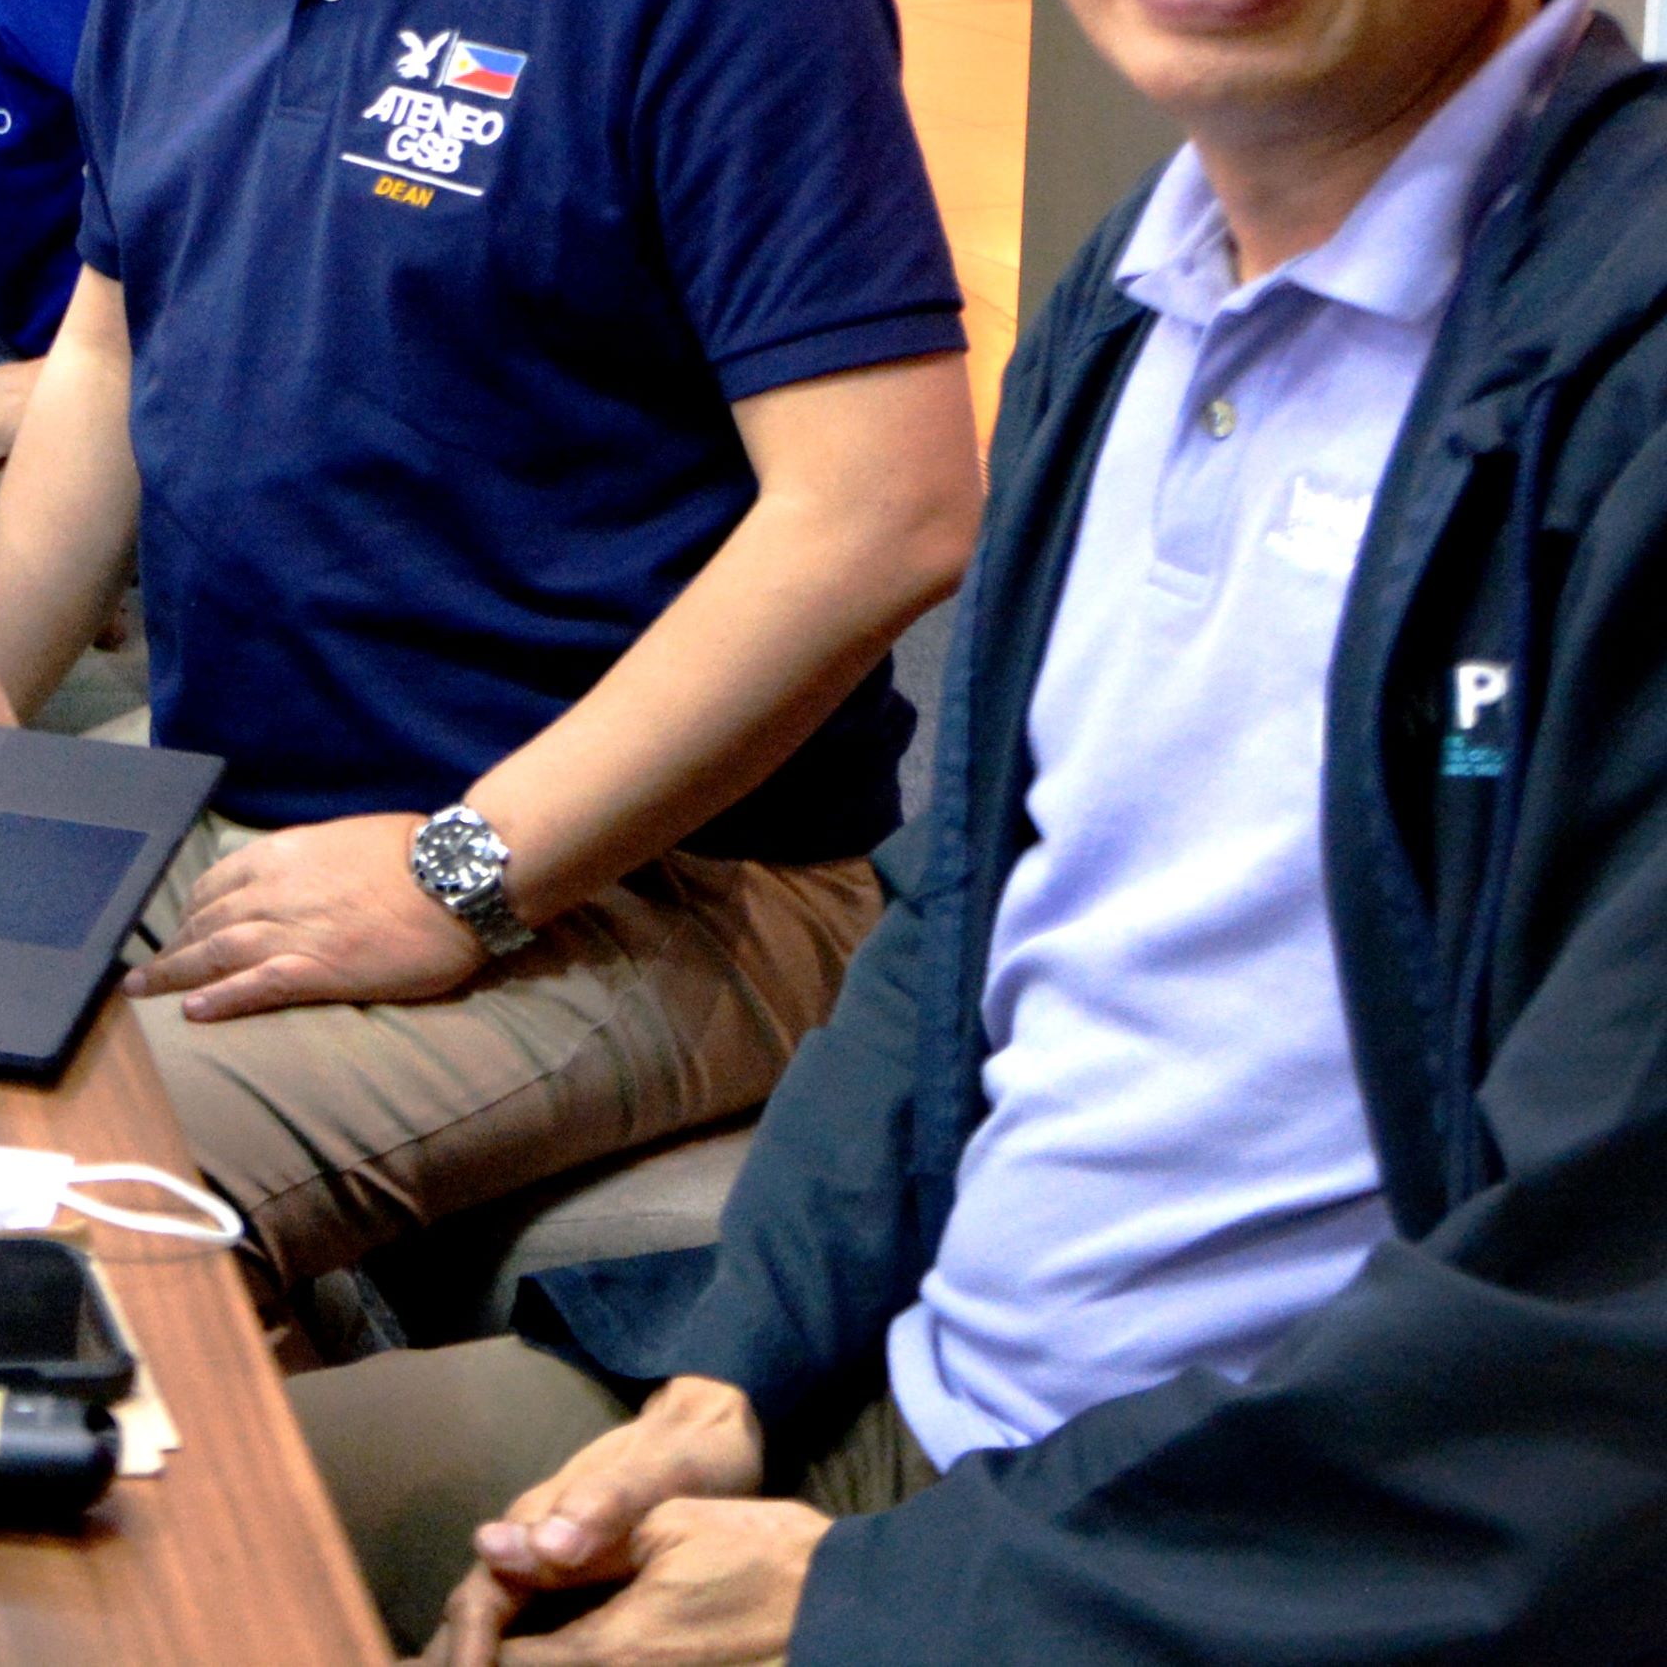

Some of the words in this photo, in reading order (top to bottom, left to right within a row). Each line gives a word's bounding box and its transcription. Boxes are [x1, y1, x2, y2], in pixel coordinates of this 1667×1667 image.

[362, 85, 505, 147] ATENEO
[386, 126, 464, 174] GSB
[374, 175, 436, 209] DEAN
